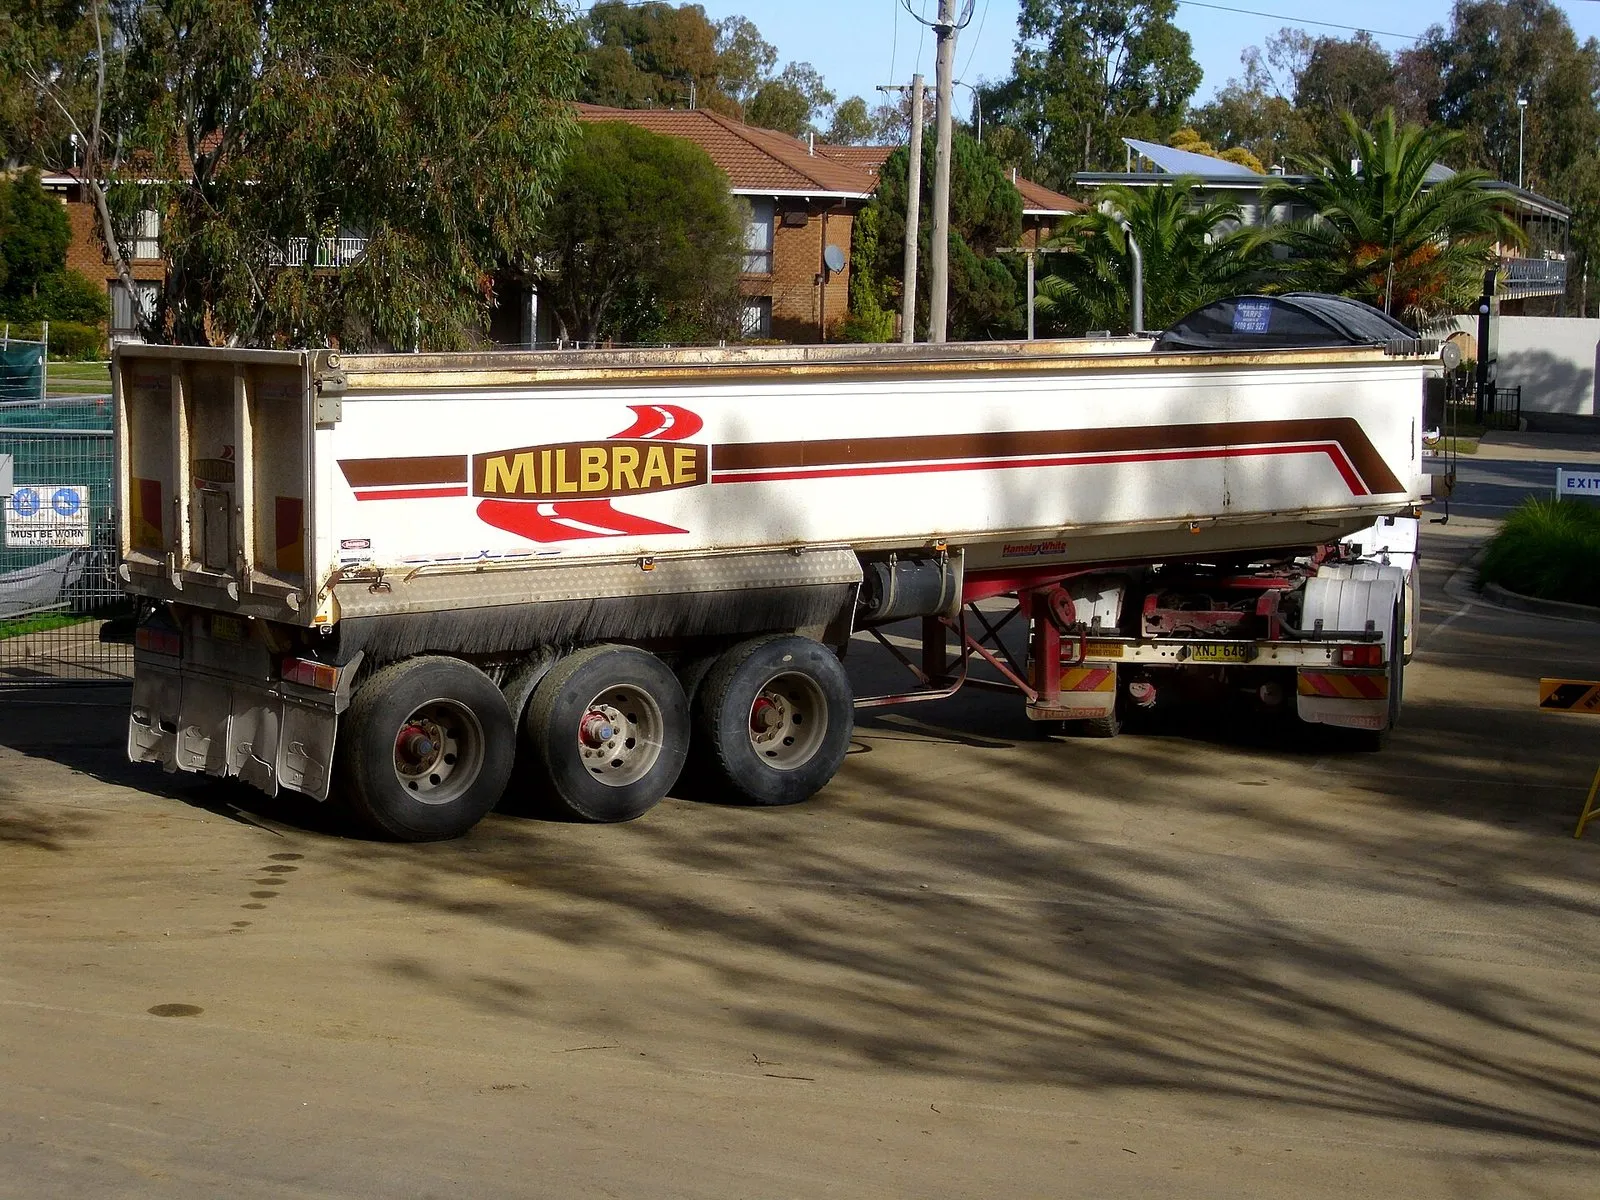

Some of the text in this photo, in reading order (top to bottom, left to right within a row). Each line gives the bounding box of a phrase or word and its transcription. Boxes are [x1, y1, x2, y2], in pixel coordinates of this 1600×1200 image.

[1242, 310, 1262, 318] TARPS
[483, 446, 697, 494] MILBRAE
[1567, 477, 1600, 489] EXIT
[11, 530, 84, 538] MUST BE WORN
